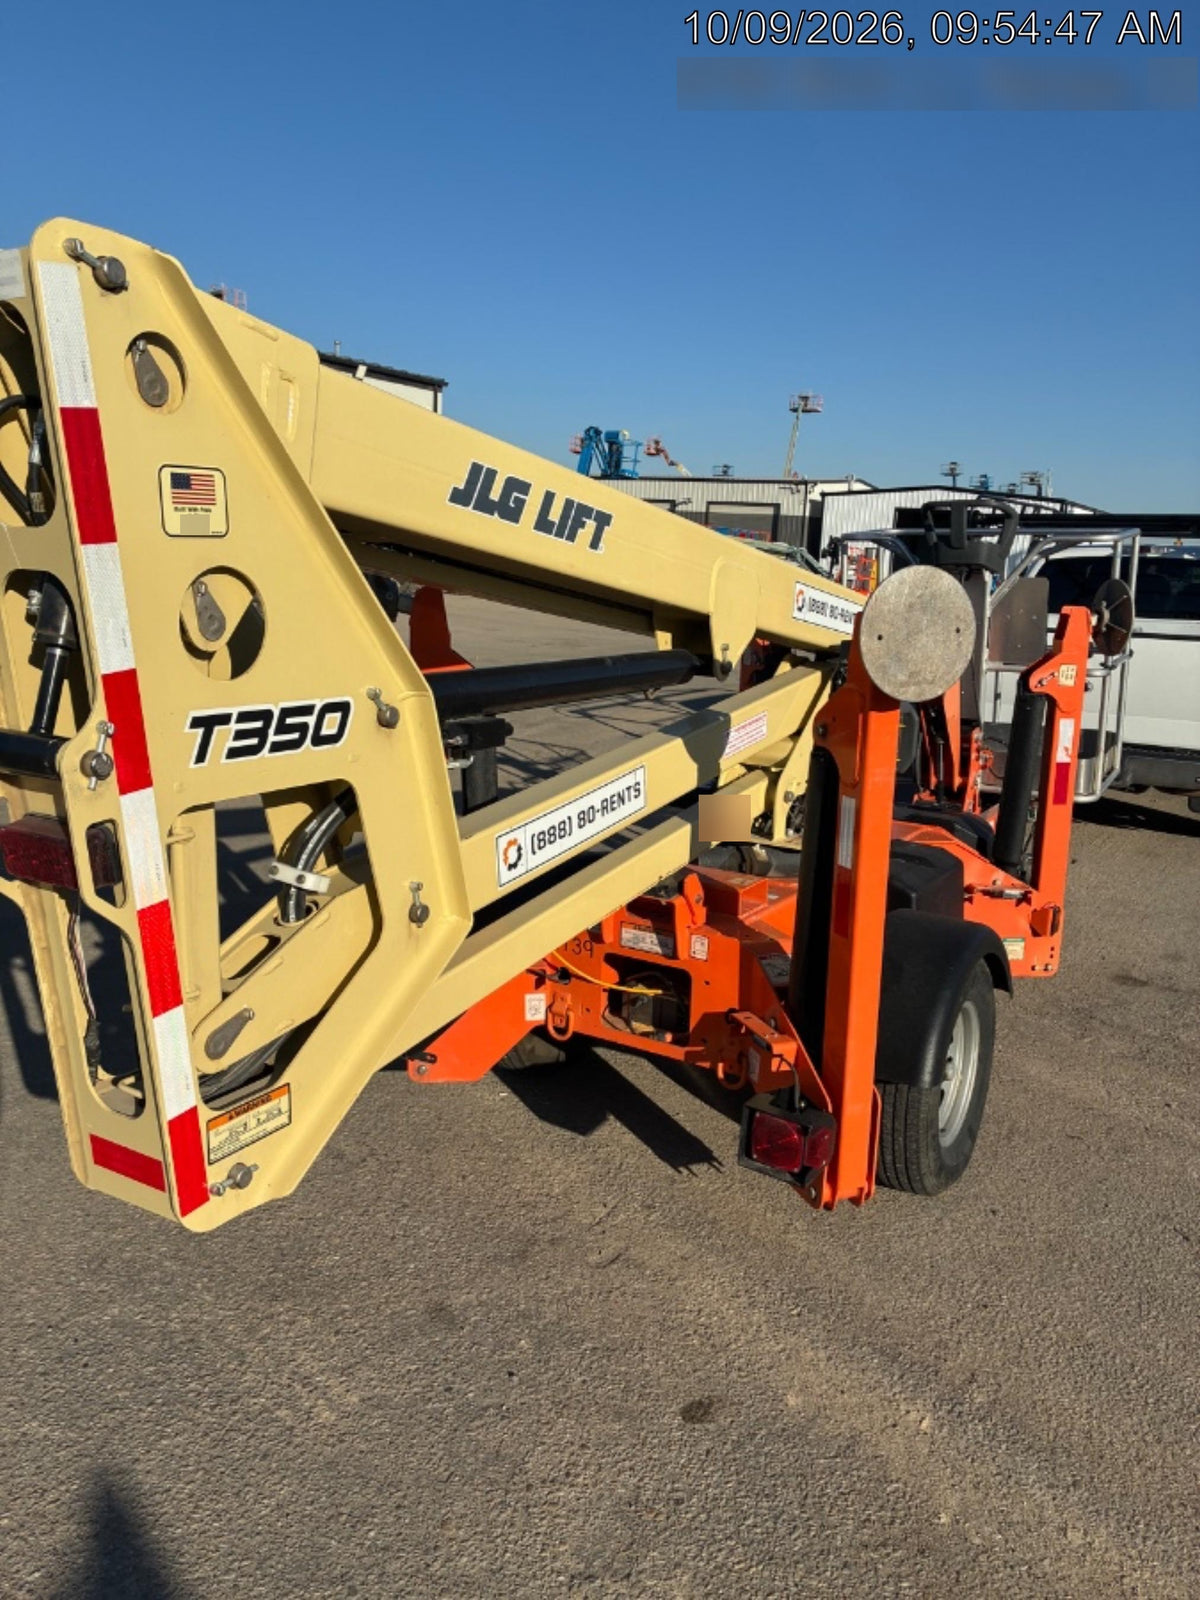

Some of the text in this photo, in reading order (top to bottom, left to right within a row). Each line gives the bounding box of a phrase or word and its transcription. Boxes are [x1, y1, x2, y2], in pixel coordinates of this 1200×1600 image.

[448, 460, 614, 552] JLG LIFT
[829, 603, 857, 625] 80-REN
[187, 698, 352, 766] T350
[530, 781, 641, 856] (888) 80-RENTS
